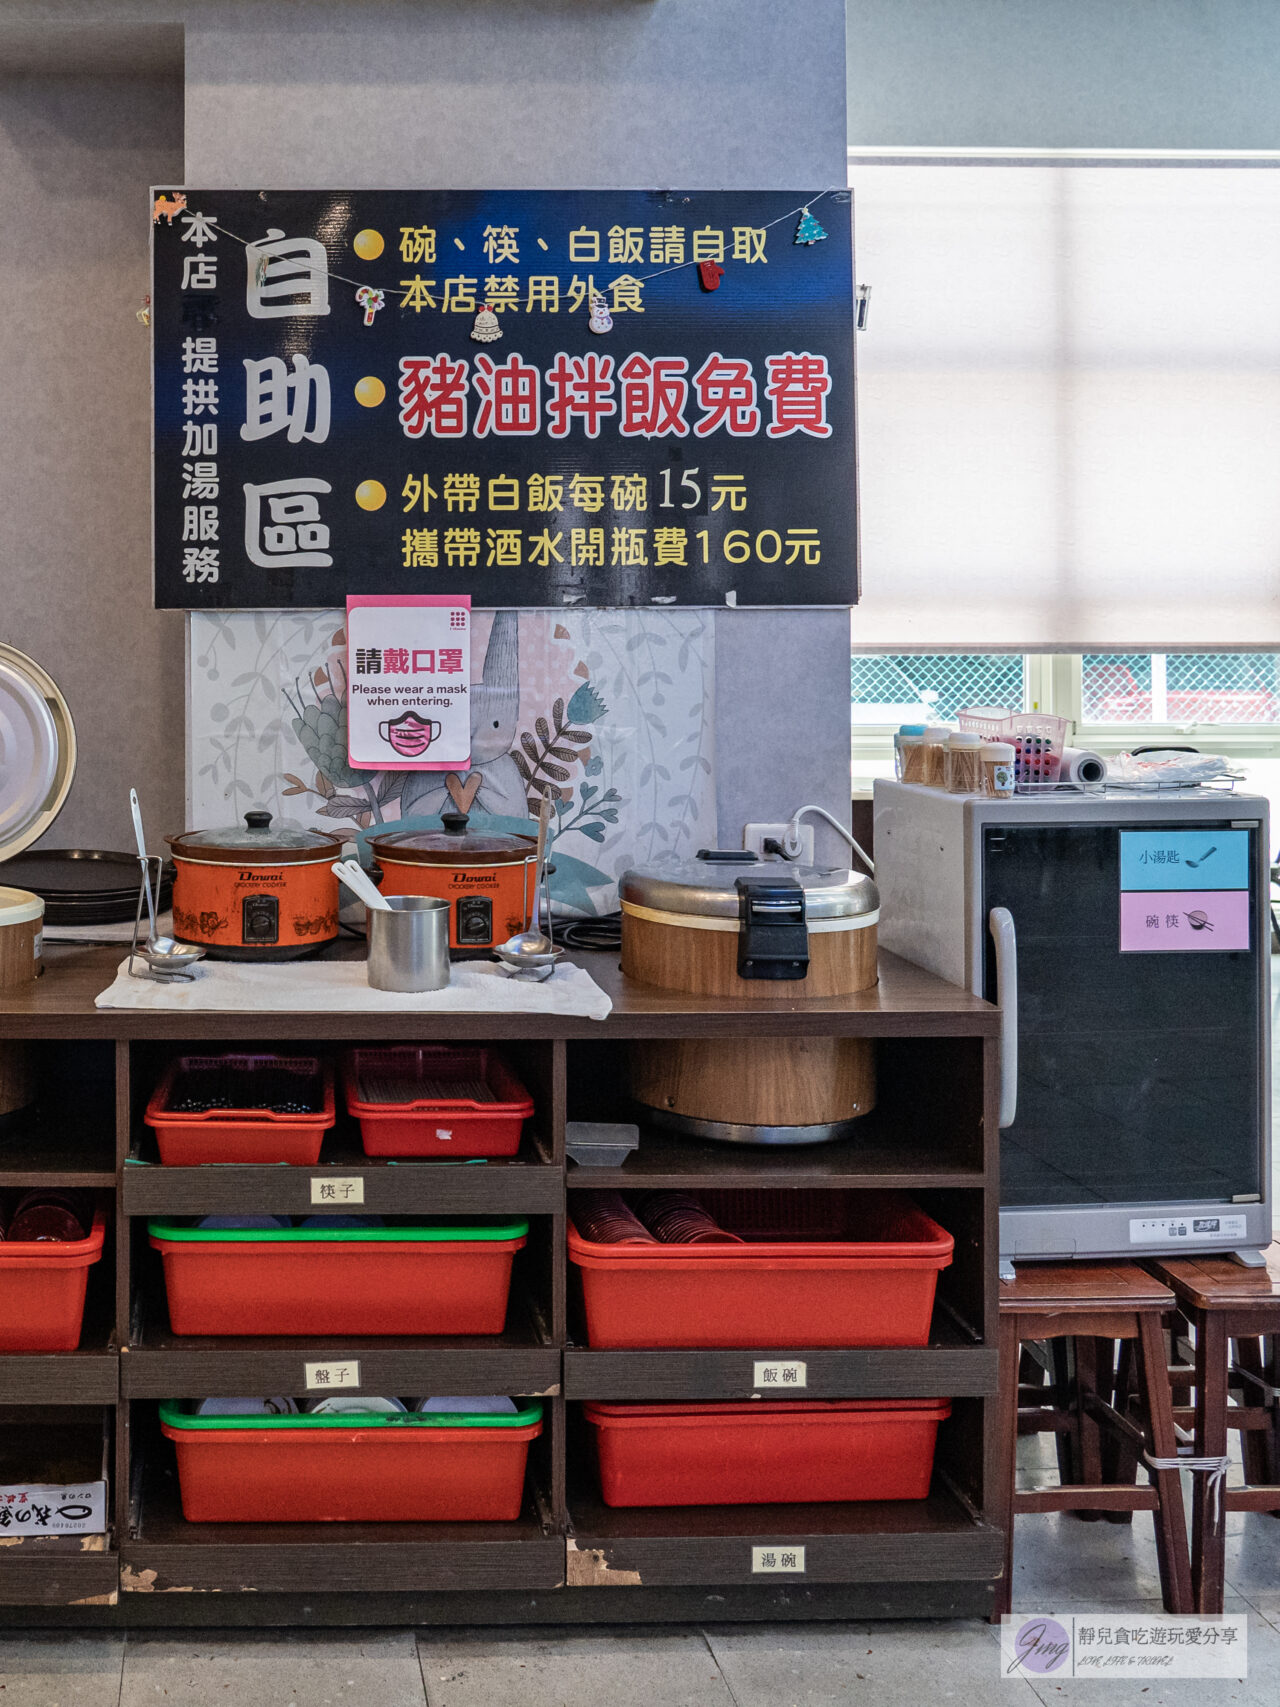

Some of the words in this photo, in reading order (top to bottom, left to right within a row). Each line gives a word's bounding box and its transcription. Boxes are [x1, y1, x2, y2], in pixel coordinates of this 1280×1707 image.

[181, 212, 218, 290] 本店
[399, 273, 646, 314] 本店禁用外食
[240, 228, 334, 569] 自助區
[398, 351, 833, 439] 豬油拌飯免費
[401, 467, 748, 513] 外帶白飯每碗15元
[401, 527, 821, 568] 攜帶酒水開瓶費160元
[355, 648, 464, 675] 請戴口罩
[352, 684, 391, 694] Please
[394, 686, 423, 694] wear
[436, 684, 467, 694] mask
[367, 696, 399, 706] when
[401, 697, 453, 708] entering.
[1139, 850, 1180, 865] 小湯匙
[319, 1183, 355, 1199] 筷子
[315, 1367, 350, 1384] 盤子
[762, 1366, 799, 1384] 飯碗
[760, 1552, 798, 1569] 湯碗
